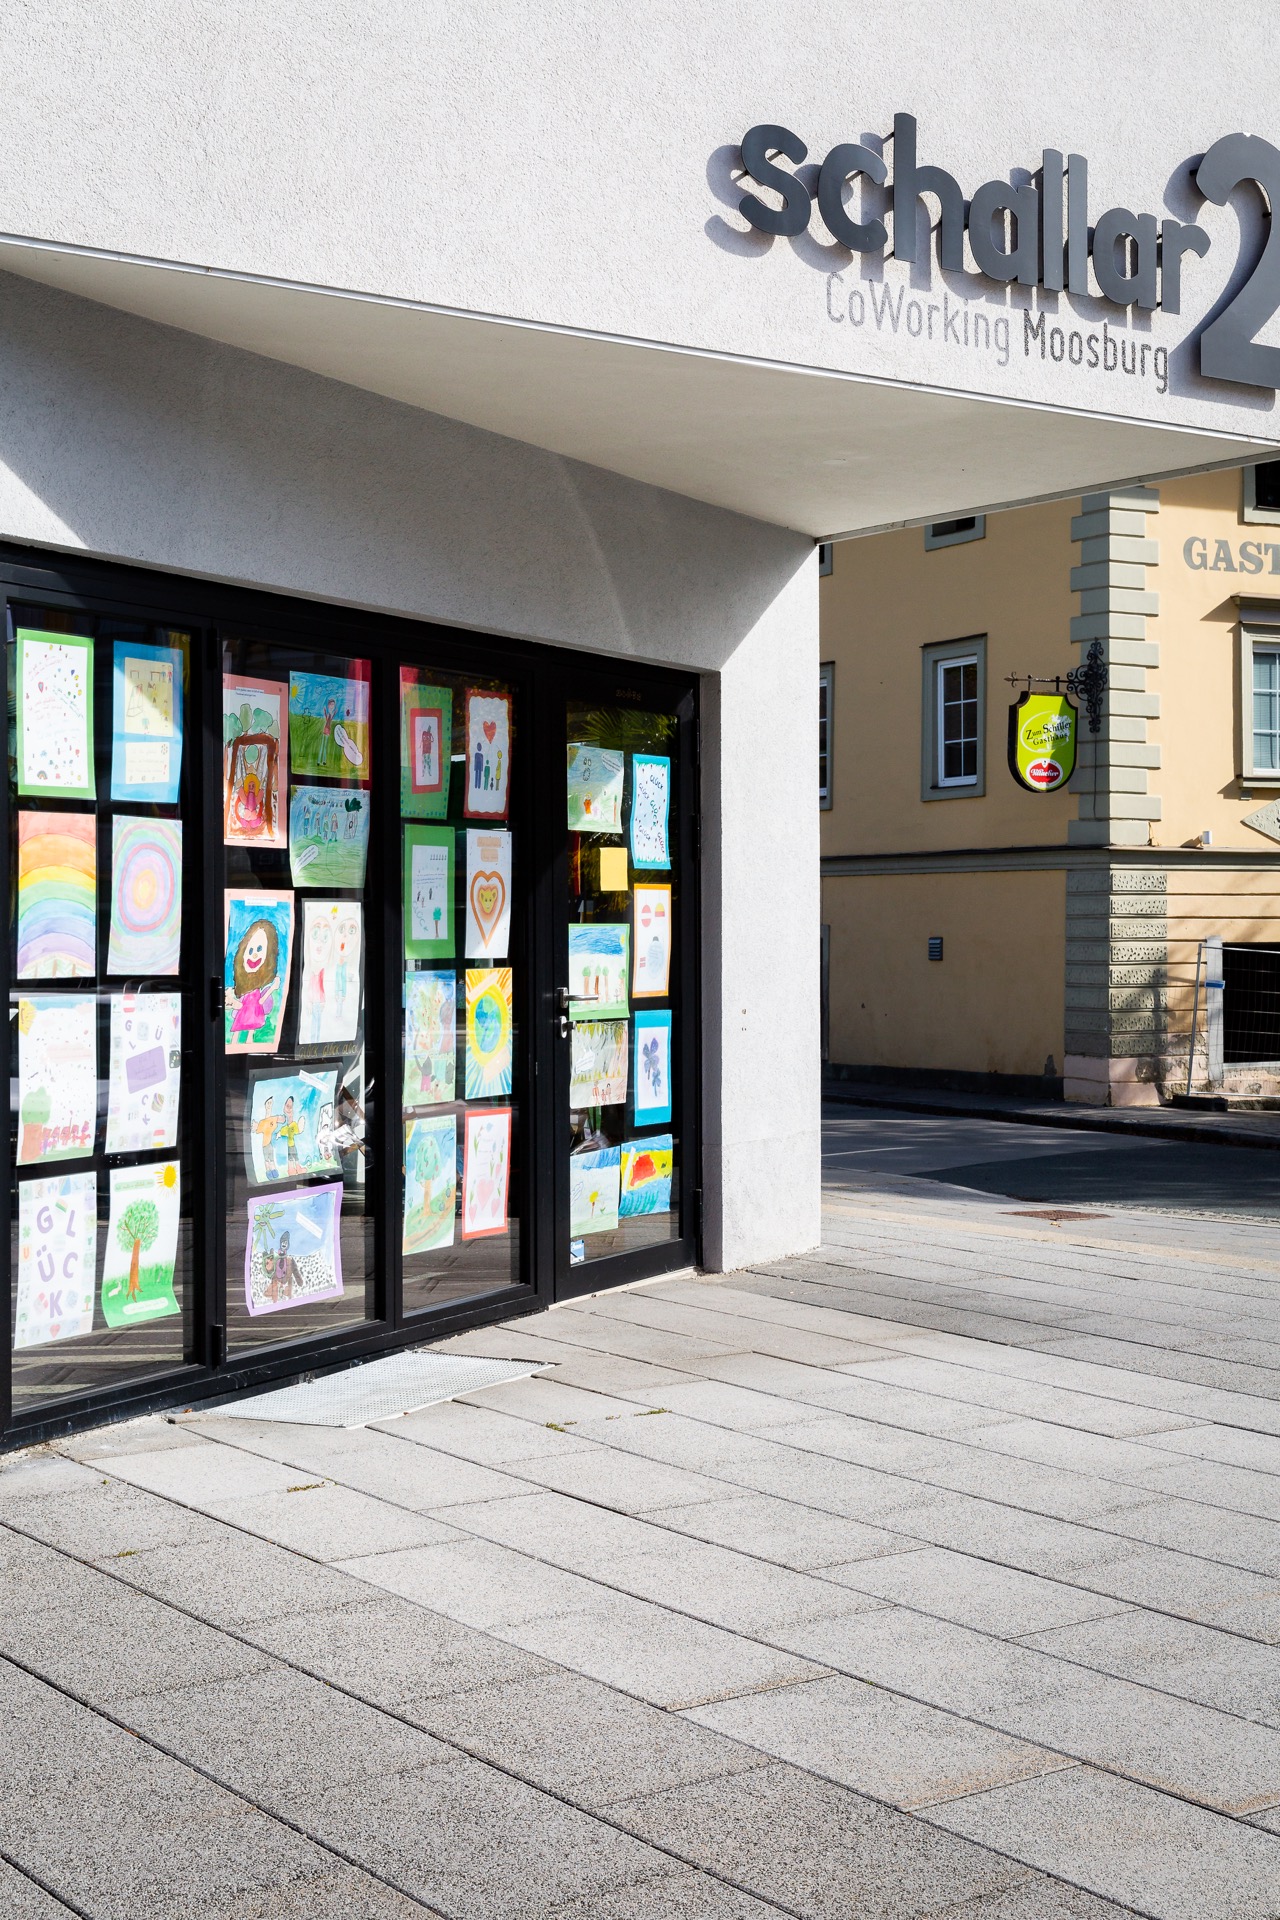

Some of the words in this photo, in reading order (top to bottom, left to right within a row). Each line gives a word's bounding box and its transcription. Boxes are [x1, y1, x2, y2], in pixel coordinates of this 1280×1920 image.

[826, 271, 1011, 367] CoWorking
[1023, 308, 1170, 394] Moosburg
[1026, 729, 1042, 740] Zum
[1042, 721, 1072, 734] Schiller
[1032, 734, 1068, 746] Gasthaus
